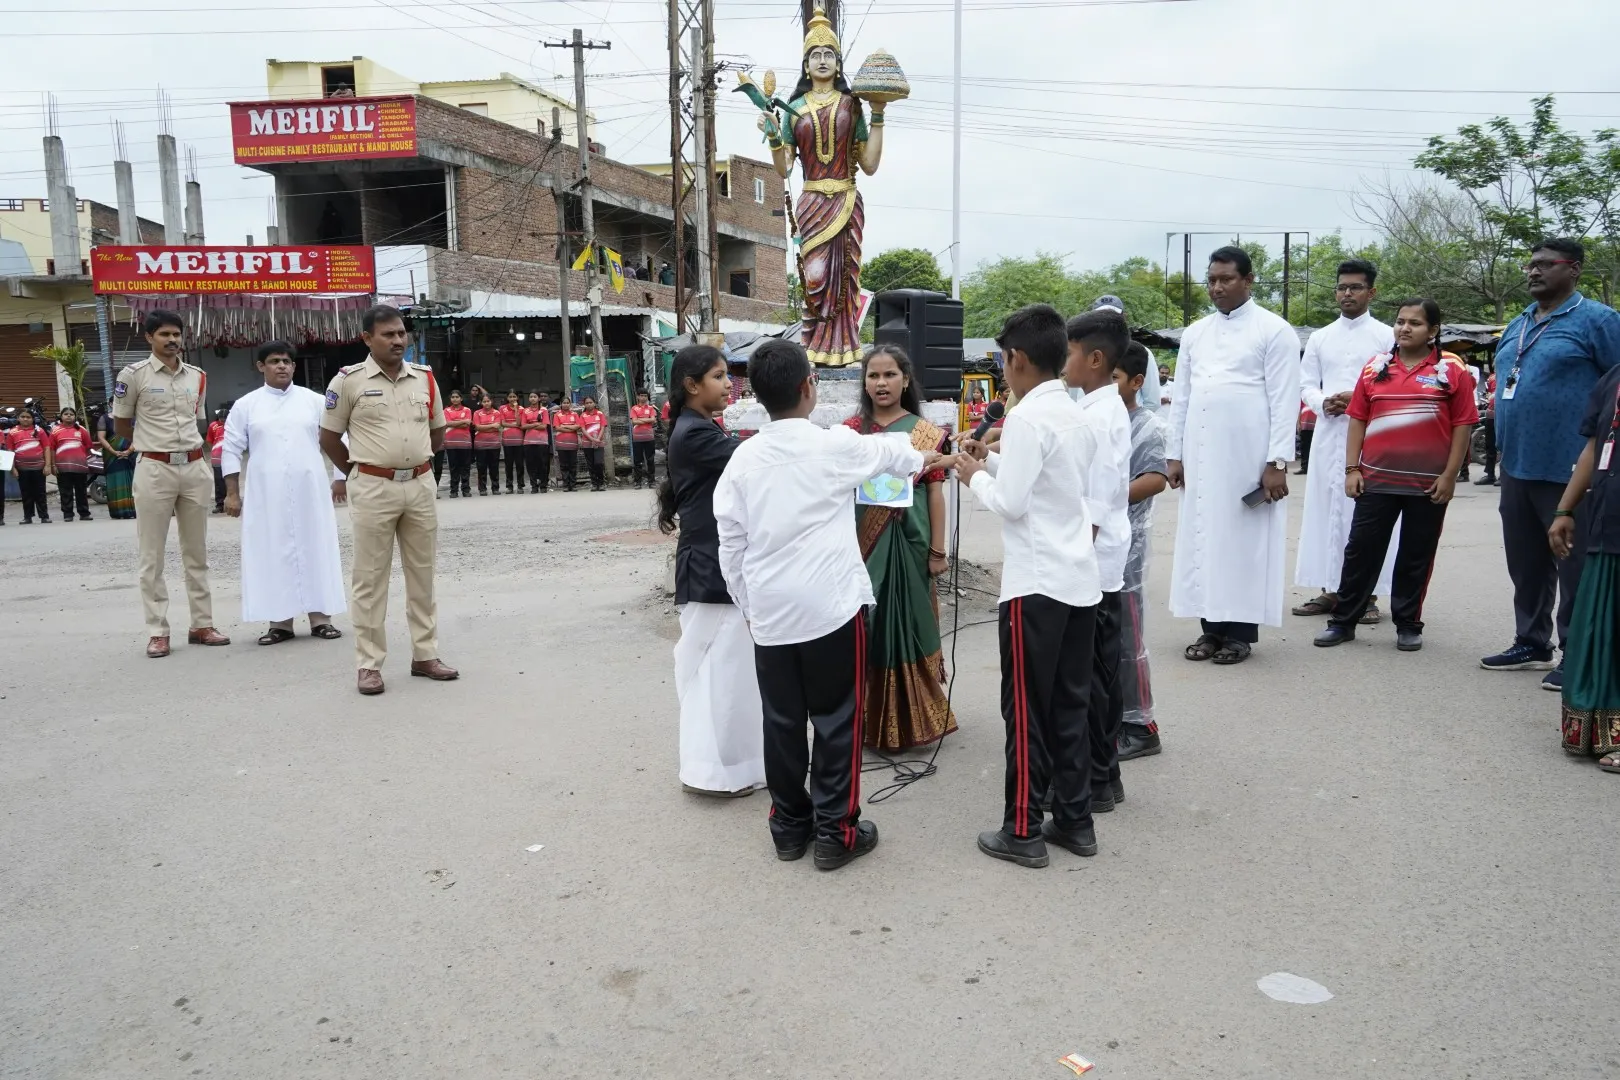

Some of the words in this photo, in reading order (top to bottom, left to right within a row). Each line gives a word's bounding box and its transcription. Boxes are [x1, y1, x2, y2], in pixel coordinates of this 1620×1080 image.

[248, 105, 374, 135] MEHFIL
[237, 147, 257, 156] MULTI
[259, 145, 286, 156] CUISINE
[287, 144, 310, 155] FAMILY
[312, 142, 357, 155] RESTAURANT
[360, 142, 365, 152] &
[366, 141, 389, 152] MANDI
[390, 140, 414, 151] HOUSE
[97, 253, 112, 261] The
[114, 253, 133, 262] New
[136, 251, 313, 274] MEHFIL
[99, 281, 126, 291] MULTI
[127, 281, 162, 290] CUISINE
[164, 281, 194, 290] FAMILY
[196, 280, 250, 290] RESTAURANT
[253, 281, 259, 290] &
[261, 280, 288, 290] MANDI
[290, 280, 318, 290] HOUSE
